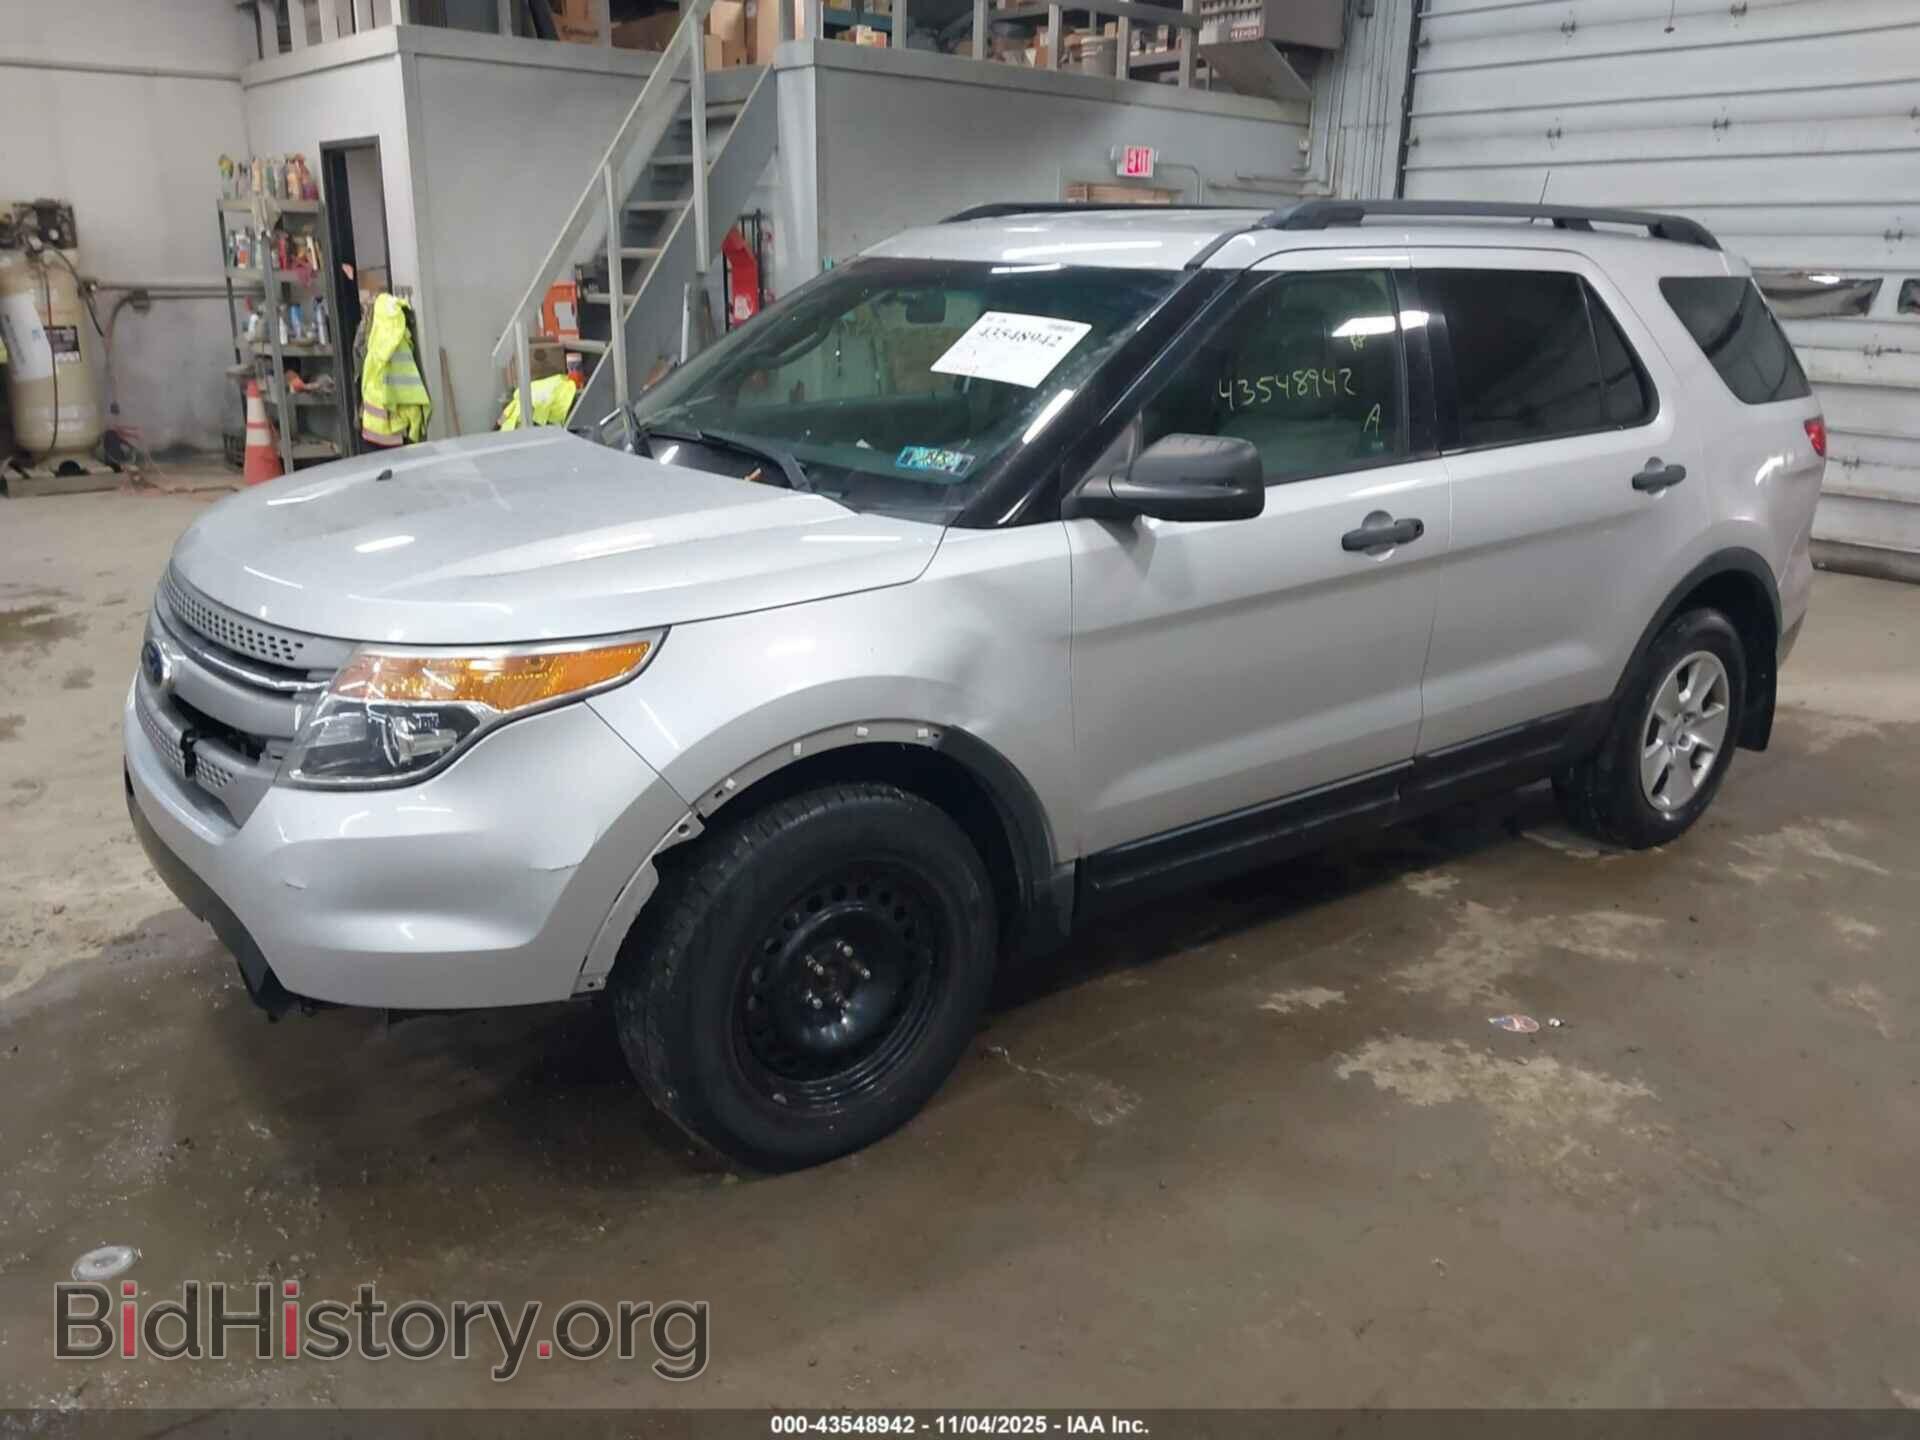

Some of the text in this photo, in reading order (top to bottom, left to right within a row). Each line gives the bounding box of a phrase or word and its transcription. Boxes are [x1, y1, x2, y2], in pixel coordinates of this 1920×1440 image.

[1127, 148, 1150, 174] EXIT
[1218, 368, 1357, 411] 43548942
[1363, 402, 1382, 436] A
